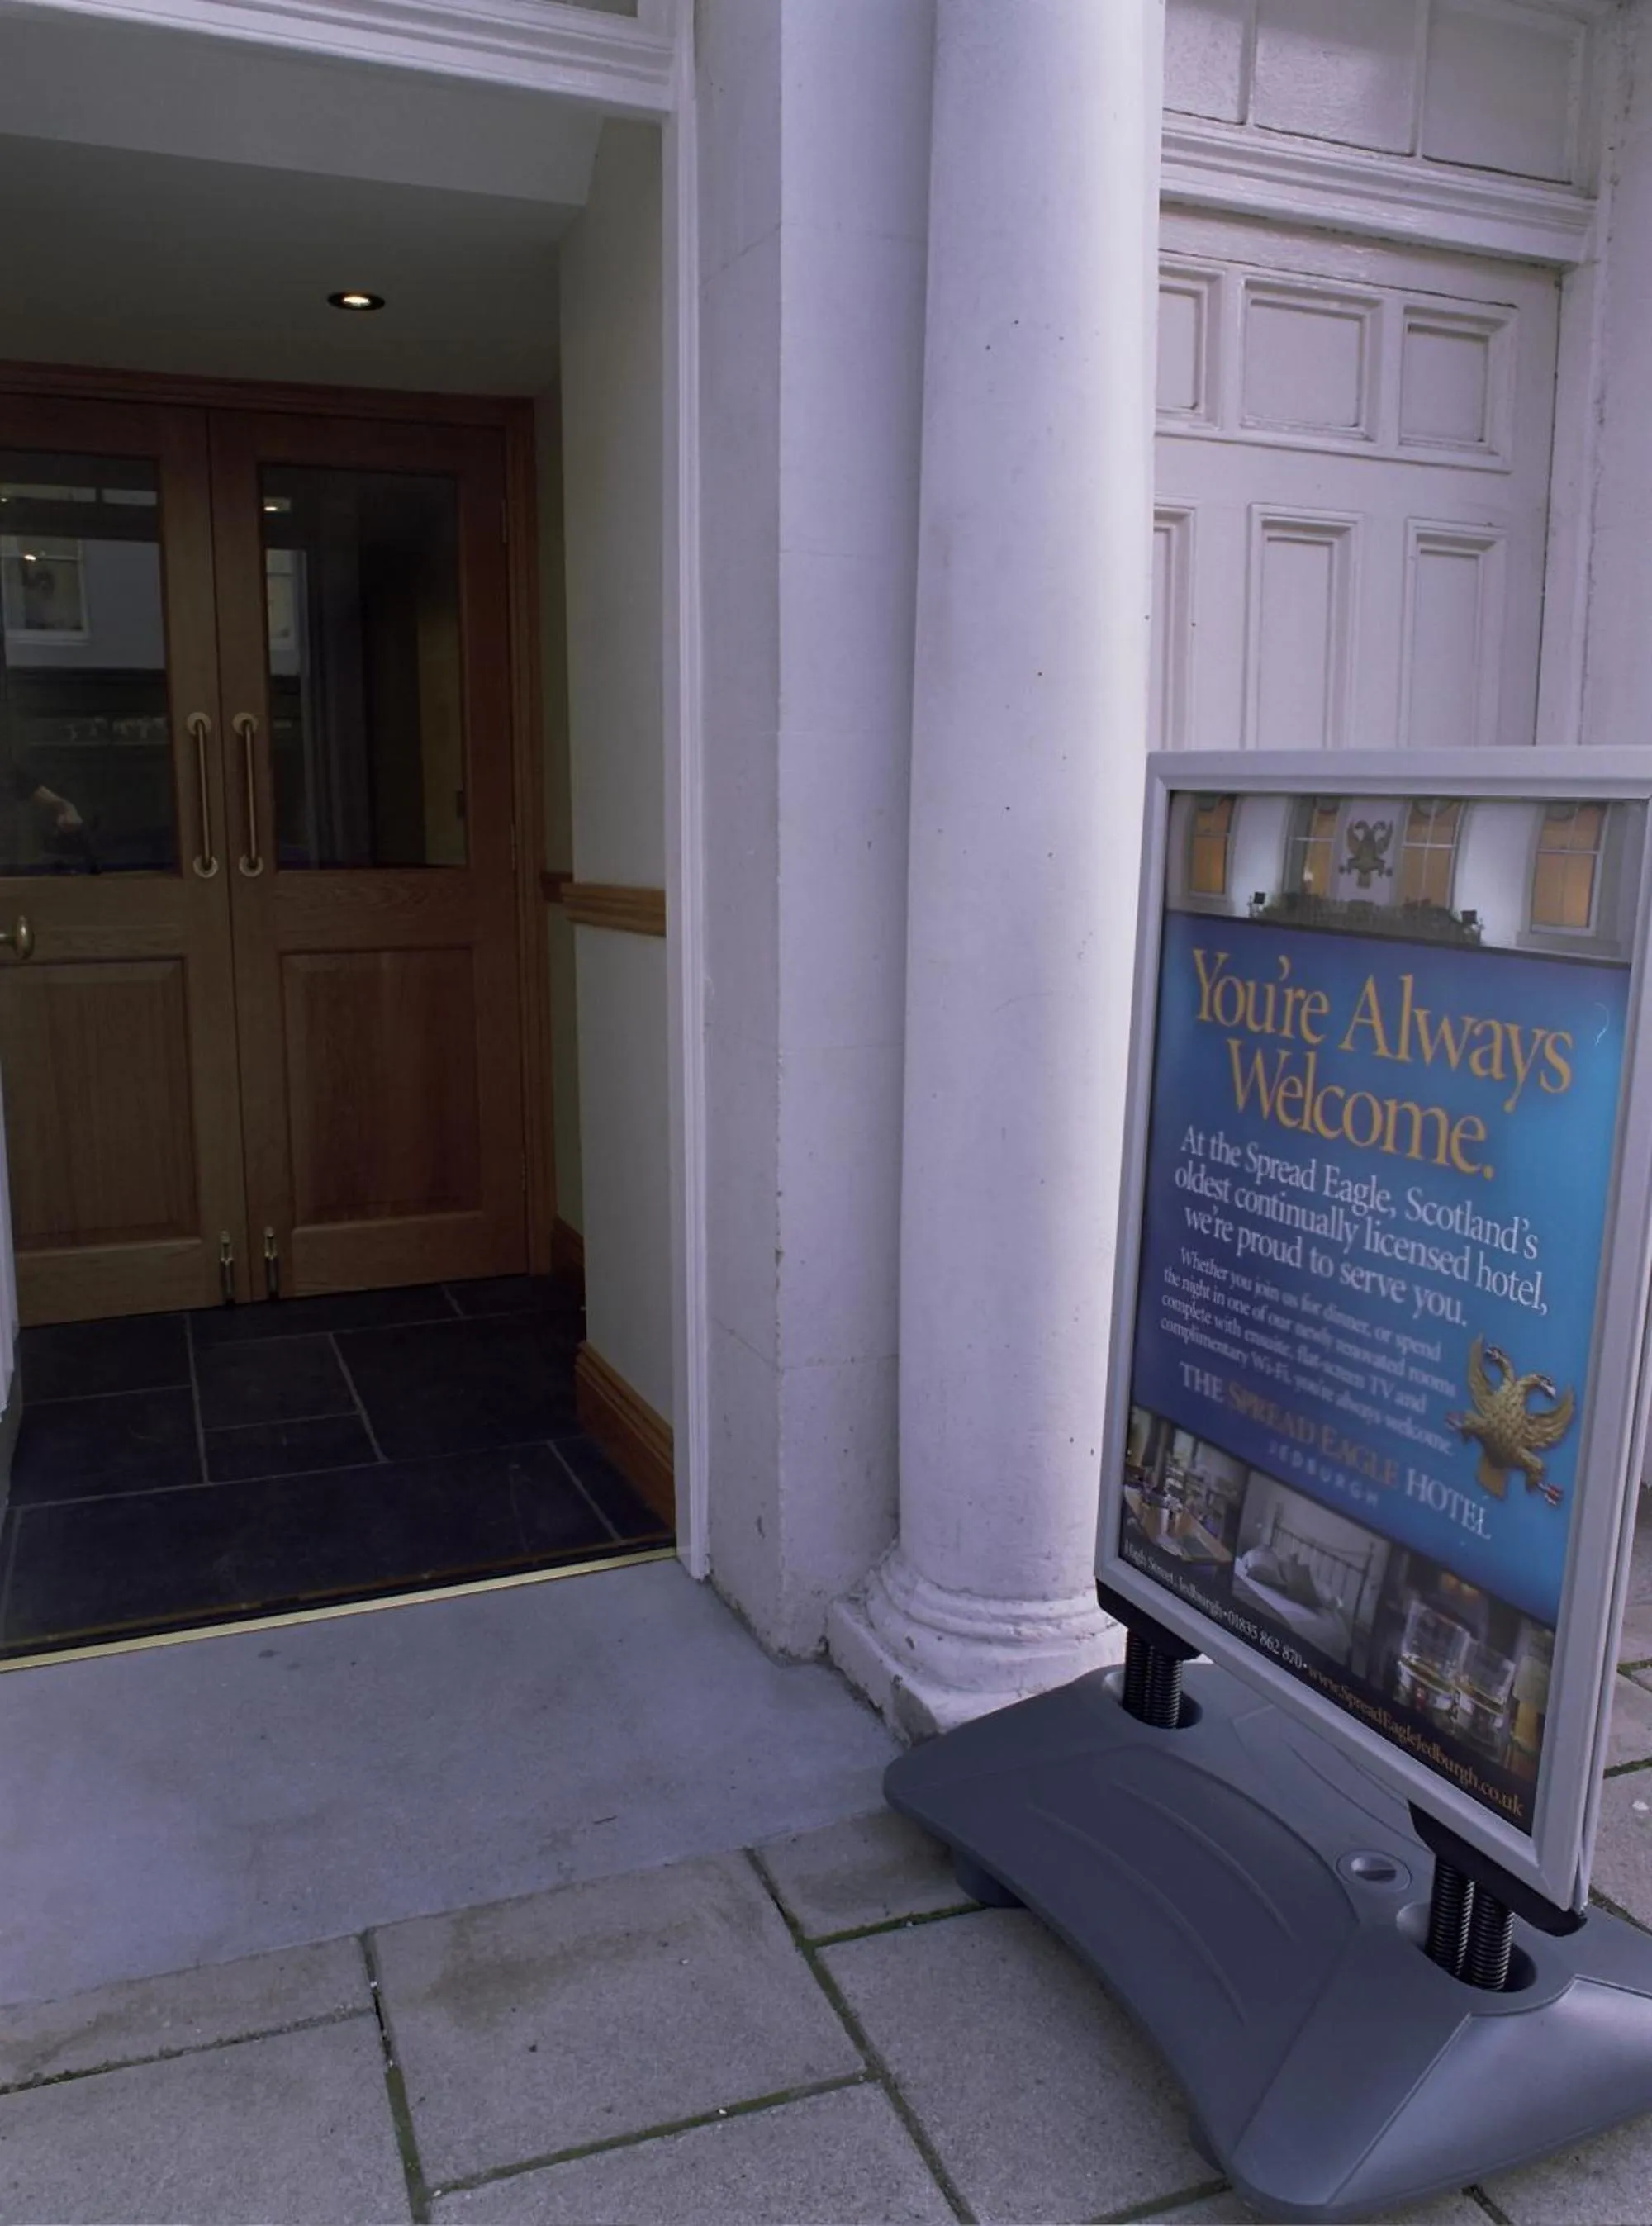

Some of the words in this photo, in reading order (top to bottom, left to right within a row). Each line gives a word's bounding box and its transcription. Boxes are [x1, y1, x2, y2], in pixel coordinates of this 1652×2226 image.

[1193, 948, 1331, 1046] You're
[1338, 974, 1574, 1113] Always
[1227, 1038, 1494, 1179] Welcome.
[1175, 1160, 1232, 1204] oldest
[1234, 1187, 1359, 1255] continually
[1364, 1216, 1471, 1281] licensed
[1475, 1249, 1548, 1317] hotel,
[1181, 1125, 1204, 1156] At
[1210, 1130, 1241, 1168] the
[1244, 1141, 1317, 1192] Spread
[1322, 1164, 1397, 1219] Eagle,
[1405, 1186, 1539, 1260] Scotland's
[1181, 1246, 1229, 1280] Whether
[1229, 1271, 1252, 1291] you
[1254, 1275, 1279, 1302] join
[1282, 1291, 1298, 1308] us
[1301, 1292, 1322, 1316] for
[1374, 1326, 1392, 1343] or
[1395, 1334, 1441, 1362] spend
[1184, 1204, 1233, 1242] we're
[1236, 1226, 1303, 1269] proud
[1309, 1246, 1334, 1279] to
[1339, 1262, 1407, 1303] serve
[1412, 1283, 1468, 1327] you.
[1161, 1317, 1250, 1369] complimentary
[1161, 1294, 1213, 1325] complete
[1214, 1315, 1241, 1337] with
[1370, 1374, 1395, 1398] TV
[1394, 1390, 1427, 1414] and
[1164, 1265, 1180, 1287] the
[1181, 1274, 1210, 1300] night
[1213, 1285, 1226, 1307] in
[1227, 1298, 1251, 1316] one
[1251, 1304, 1269, 1322] of
[1268, 1312, 1293, 1331] our
[1408, 1366, 1457, 1398] rooms
[1179, 1361, 1225, 1403] THE
[1406, 1467, 1492, 1540] HOTEL
[1269, 1438, 1379, 1507] JEDBURGH
[1259, 1631, 1280, 1654] 862
